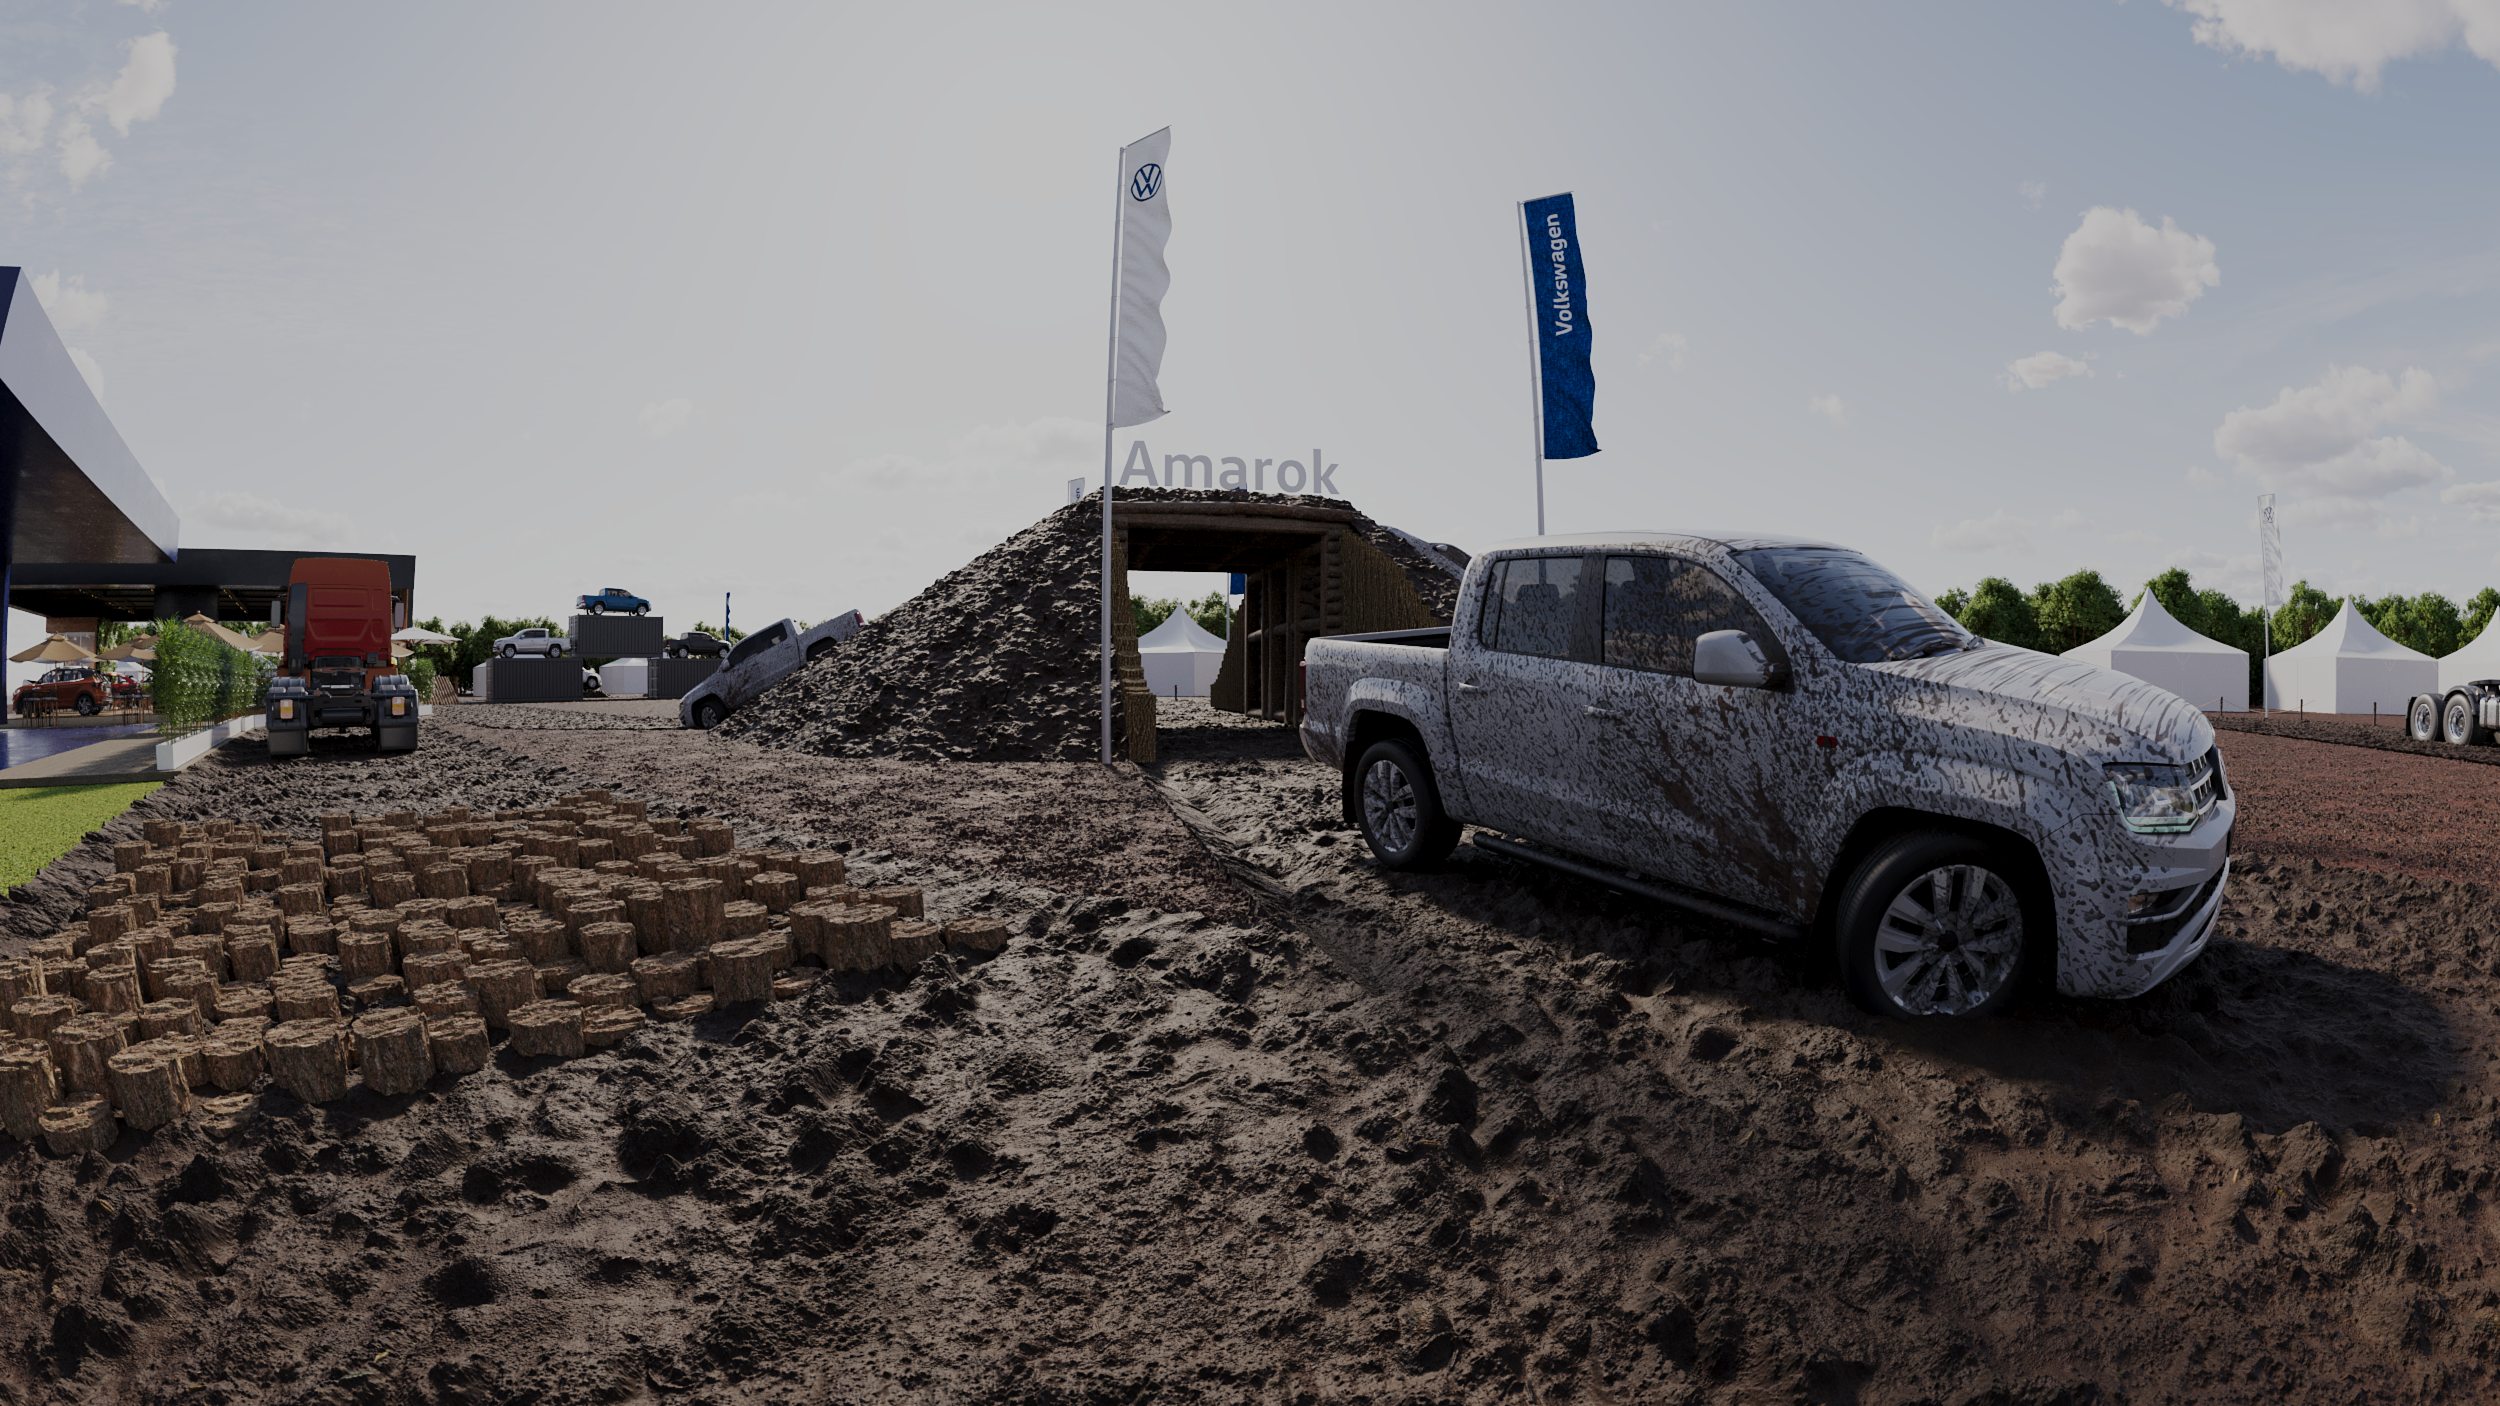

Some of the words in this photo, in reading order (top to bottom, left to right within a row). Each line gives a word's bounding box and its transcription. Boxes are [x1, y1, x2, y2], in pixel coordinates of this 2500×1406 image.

[1132, 163, 1162, 201] VW
[1547, 213, 1573, 336] Volkswagen
[1118, 440, 1340, 495] Amarok
